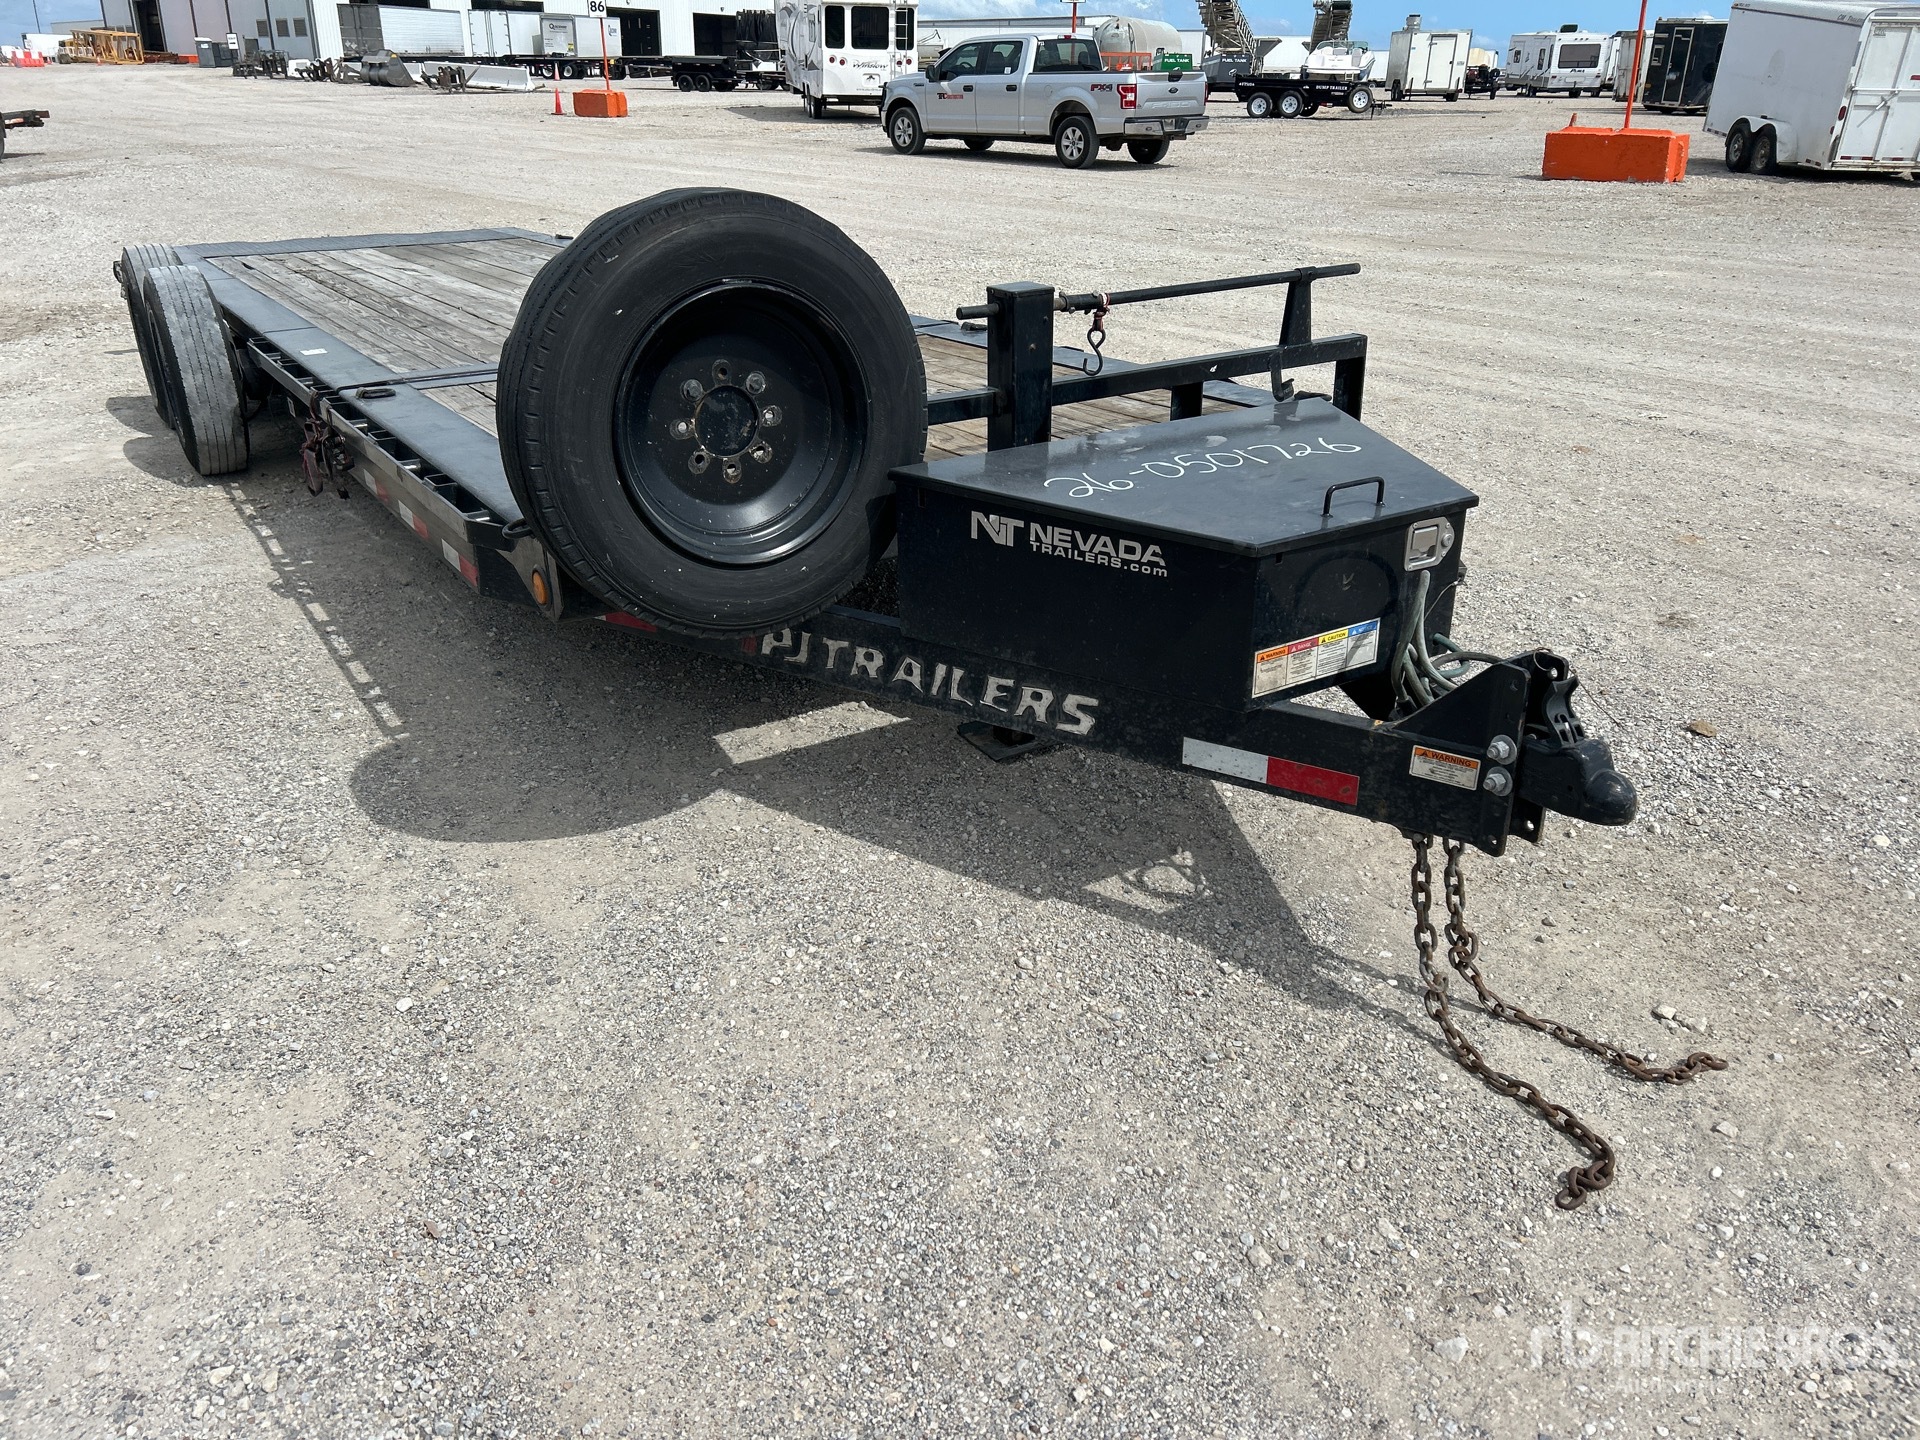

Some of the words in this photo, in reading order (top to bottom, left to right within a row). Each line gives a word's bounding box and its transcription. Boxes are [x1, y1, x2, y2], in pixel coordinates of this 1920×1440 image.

[590, 0, 605, 12] 86
[1043, 437, 1362, 498] 26-0501726
[1029, 522, 1167, 567] NEVADA
[1029, 540, 1169, 578] TRAILERS.com
[1327, 631, 1347, 641] CAUTION
[1297, 641, 1315, 650] DANGE
[1265, 649, 1286, 659] WARNING
[760, 627, 812, 664] PJ
[822, 636, 1100, 736] TRAILERS
[1431, 752, 1472, 767] WARNING
